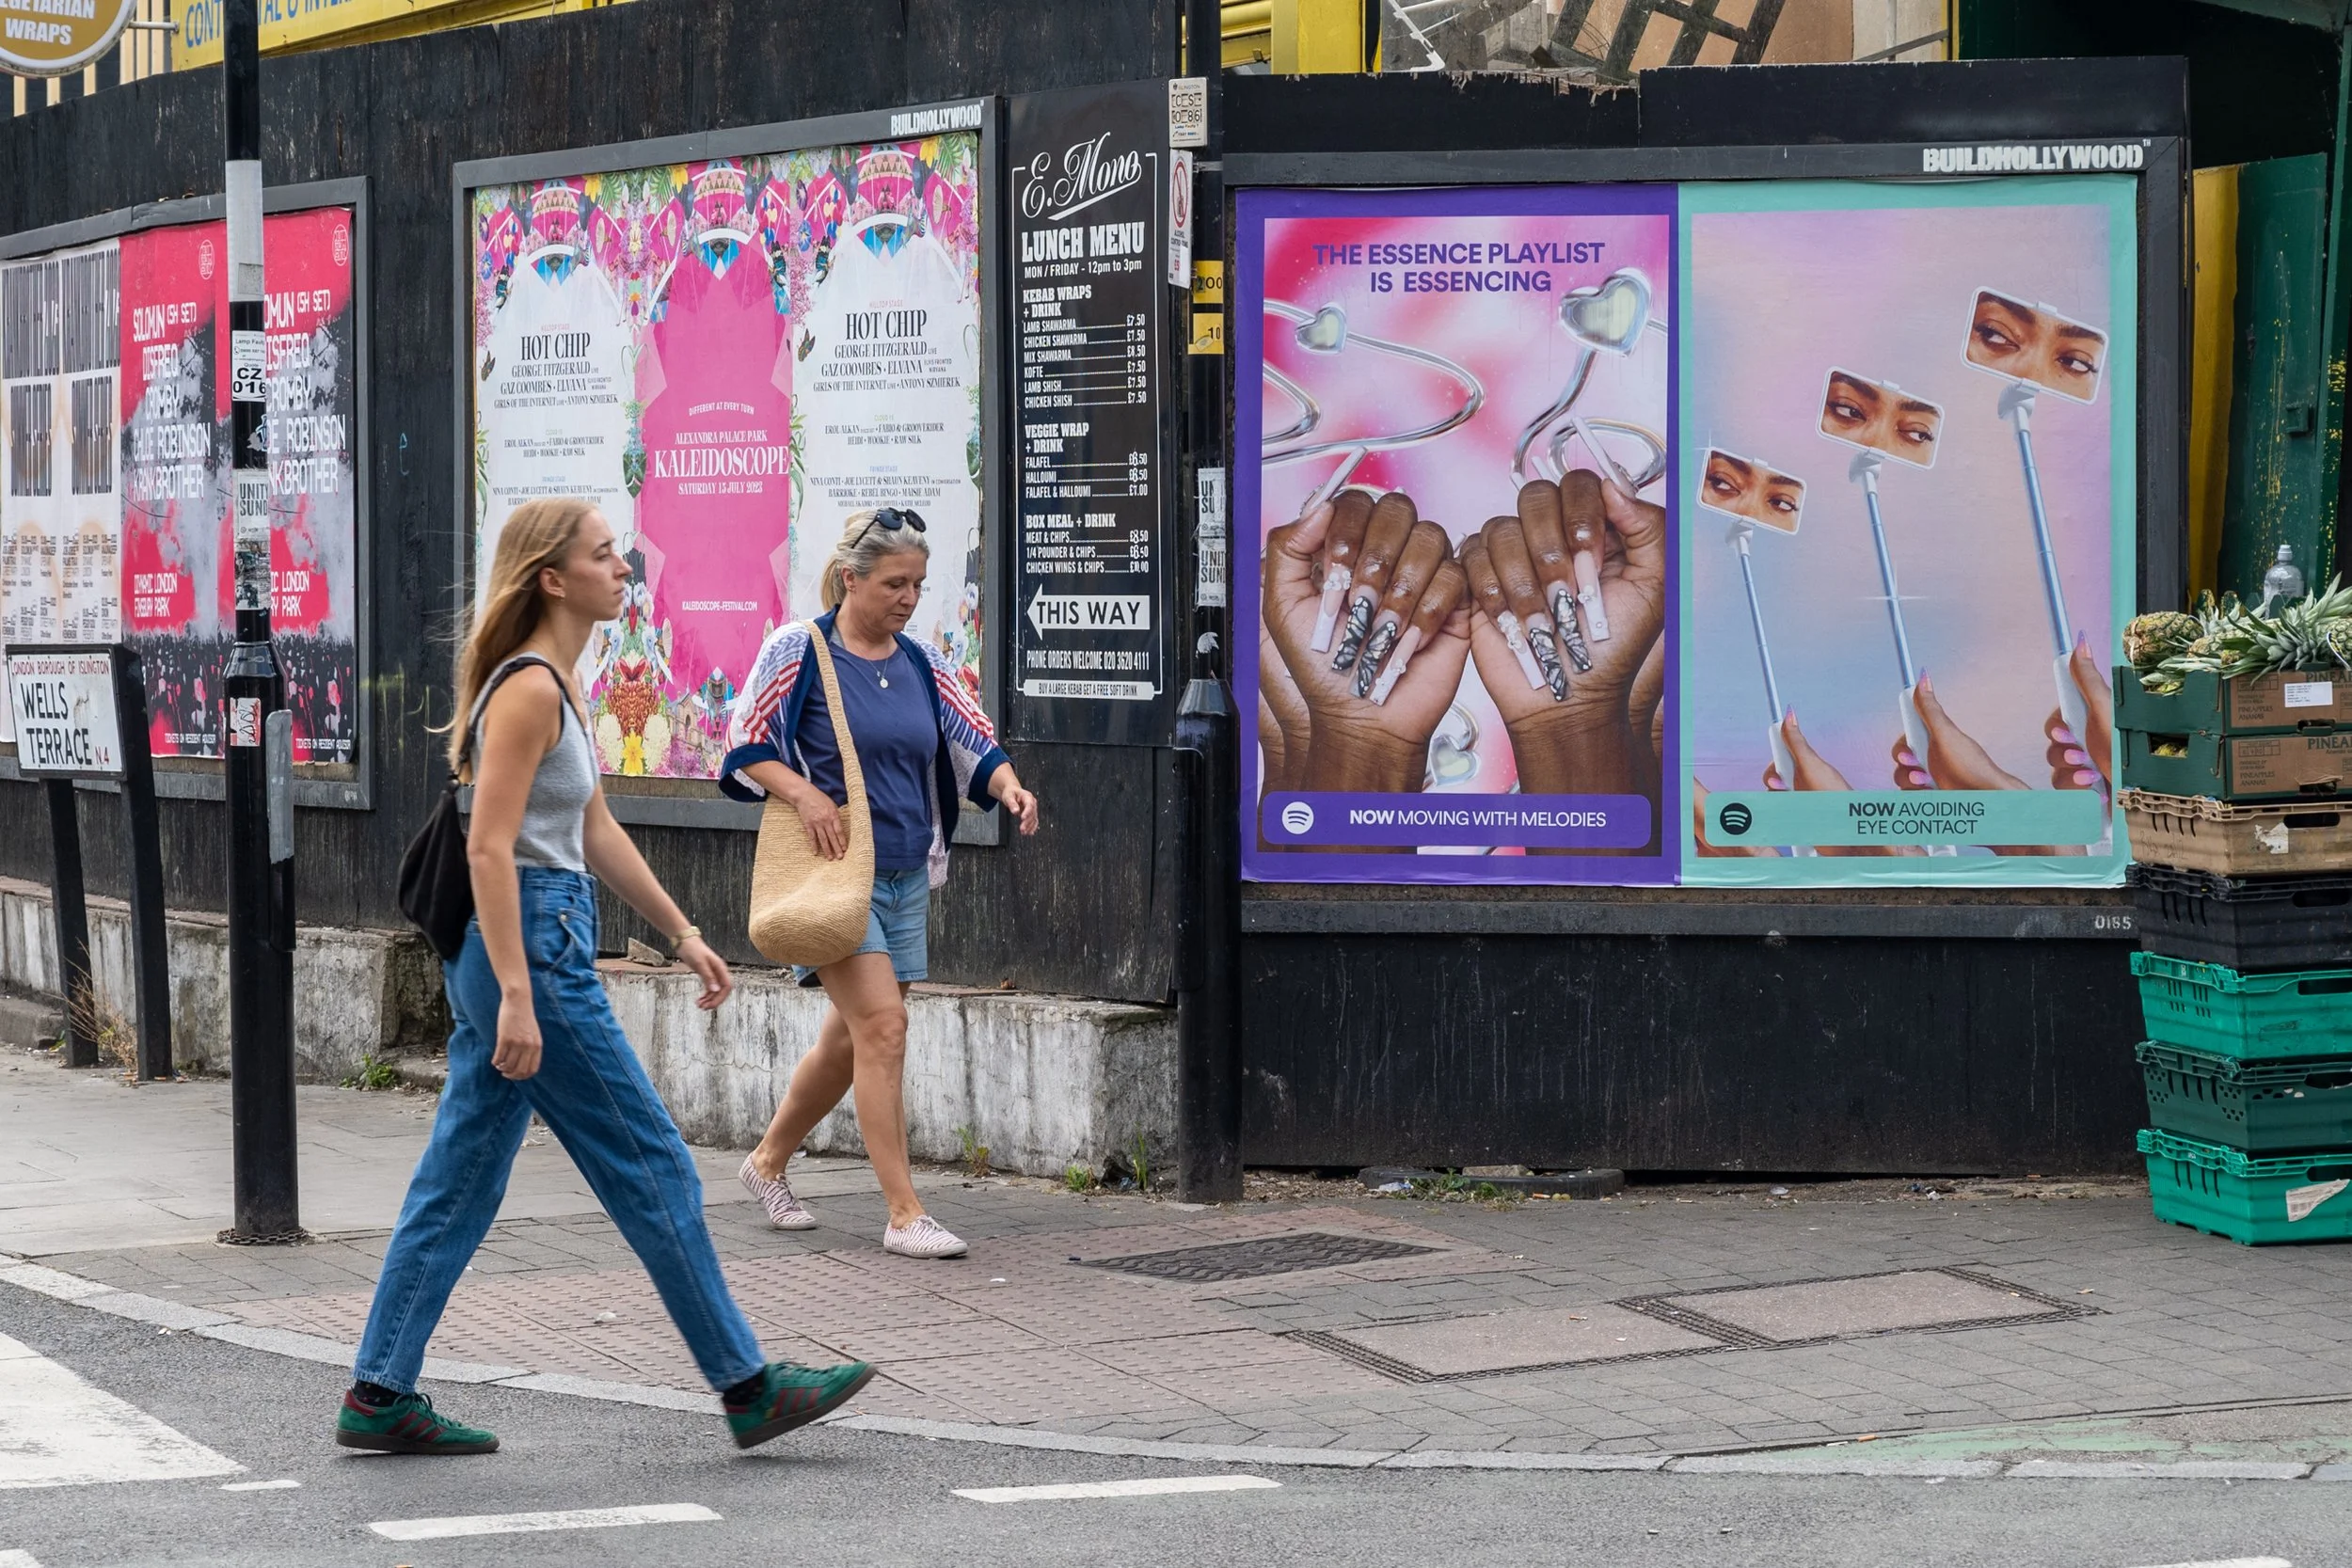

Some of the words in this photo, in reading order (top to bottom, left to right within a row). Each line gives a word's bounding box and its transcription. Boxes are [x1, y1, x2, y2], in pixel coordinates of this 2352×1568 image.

[6, 18, 72, 45] WRAPS
[891, 104, 981, 135] BUILDHOLLYWOOD
[1923, 145, 2143, 172] BUILDHOLLYWOOD
[1053, 132, 1141, 207] Mono
[1022, 228, 1083, 262] LUNCH
[1089, 222, 1145, 257] MENU
[1313, 244, 1362, 265] THE
[1369, 243, 1482, 265] ESSENCE
[1488, 242, 1605, 264] PLAYLIST
[1025, 266, 1042, 278] MON
[1050, 263, 1078, 277] FRIDAY
[1089, 261, 1110, 275] 12pm
[1113, 261, 1120, 271] to
[1123, 259, 1141, 273] 3pm
[1371, 272, 1392, 292] IS
[1404, 271, 1550, 292] ESSENCING
[1024, 288, 1055, 303] KEBAB
[1057, 285, 1091, 300] WRAPS
[1032, 303, 1061, 317] DRINK
[846, 312, 882, 340] HOT
[885, 309, 927, 338] CHIP
[1024, 322, 1040, 333] LAMB
[1041, 319, 1076, 332] SHAWARMA
[521, 335, 551, 360] HOT
[555, 332, 590, 358] CHIP
[1024, 336, 1051, 348] CHICKEN
[1053, 334, 1087, 346] SHAWARMA
[1127, 329, 1145, 341] £7.50
[834, 344, 870, 358] GEORGE
[873, 341, 927, 357] FITZGERALD
[1025, 352, 1036, 363] MIX
[1038, 350, 1072, 362] SHAWARMA
[237, 368, 262, 379] CZ
[512, 364, 542, 377] GEORGE
[544, 361, 590, 375] FITZGERALD
[821, 364, 838, 376] GAZ
[840, 362, 882, 376] COOMBES
[887, 360, 923, 375] ELVANA
[1025, 366, 1043, 378] KOFTE
[1127, 360, 1145, 372] £7.50
[233, 381, 265, 394] 016
[501, 382, 516, 394] GAZ
[516, 380, 551, 394] COOMBES
[814, 382, 832, 391] GIRLS
[834, 382, 840, 391] OF
[843, 381, 852, 390] THE
[856, 380, 887, 390] INTERNET
[1025, 381, 1041, 393] LAMB
[1042, 380, 1061, 392] SHISH
[1128, 376, 1146, 388] £7.50
[1025, 396, 1052, 408] CHICKEN
[1054, 395, 1072, 406] SHISH
[1128, 391, 1146, 404] £7.50
[689, 403, 715, 416] DIFFERENT
[724, 402, 739, 410] EVERY
[741, 404, 754, 414] TURN
[287, 414, 345, 452] ROBINSON
[675, 432, 718, 444] ALEXANDRA
[720, 431, 747, 444] PALACE
[748, 430, 767, 442] PARK
[1025, 424, 1058, 438] VEGGIE
[1060, 422, 1089, 436] WRAP
[158, 422, 211, 459] ROBINSON
[1034, 438, 1063, 452] DRINK
[655, 446, 789, 478] KALEIDOSCOPE
[1025, 456, 1051, 468] FALAFEL
[1025, 471, 1056, 483] HALLOUMI
[678, 483, 716, 495] SATURDAY
[719, 483, 725, 493] 15
[726, 482, 745, 493] JULY
[1026, 486, 1051, 499] FALAFEL
[1053, 486, 1057, 498] &
[1059, 485, 1090, 497] HALLOUMI
[1026, 515, 1044, 529] BOX
[1047, 515, 1073, 528] MEAL
[1085, 514, 1116, 527] DRINK
[1026, 531, 1041, 543] MEAT
[1044, 531, 1048, 543] &
[1051, 531, 1070, 543] CHIPS
[1026, 547, 1036, 558] 1/4
[1039, 546, 1067, 558] POUNDER
[1070, 546, 1073, 558] &
[1076, 546, 1095, 558] CHIPS
[1026, 562, 1053, 573] CHICKEN
[1055, 562, 1075, 573] WINGS
[1078, 562, 1082, 573] &
[1085, 562, 1104, 573] CHIPS
[282, 571, 310, 592] LONDON
[282, 595, 301, 617] PARK
[1037, 601, 1079, 625] THIS
[1088, 602, 1140, 625] WAY
[38, 661, 65, 674] BOROUGH
[68, 661, 74, 673] OF
[1027, 650, 1046, 669] PHONE
[1048, 651, 1072, 669] ORDERS
[1073, 651, 1102, 669] WELCOME
[1104, 651, 1115, 670] 020
[1117, 652, 1132, 670] 3620
[1134, 652, 1149, 670] 4111
[1049, 684, 1052, 693] A
[1053, 684, 1066, 694] LARGE
[1068, 684, 1082, 694] KEBAB
[1093, 685, 1095, 695] A
[1097, 685, 1108, 695] FREE
[1110, 685, 1121, 695] SOFT
[1123, 685, 1137, 696] DRINK
[21, 682, 68, 720] WELLS
[26, 728, 92, 765] TERRACE
[1849, 802, 1896, 816] NOW
[1899, 802, 1985, 816] AVOIDING
[1349, 810, 1394, 825] NOW
[1398, 811, 1469, 826] MOVING
[1472, 811, 1517, 827] WITH
[1521, 812, 1606, 828] MELODIES
[1857, 820, 1888, 834] EYE
[1891, 820, 1979, 834] CONTACT
